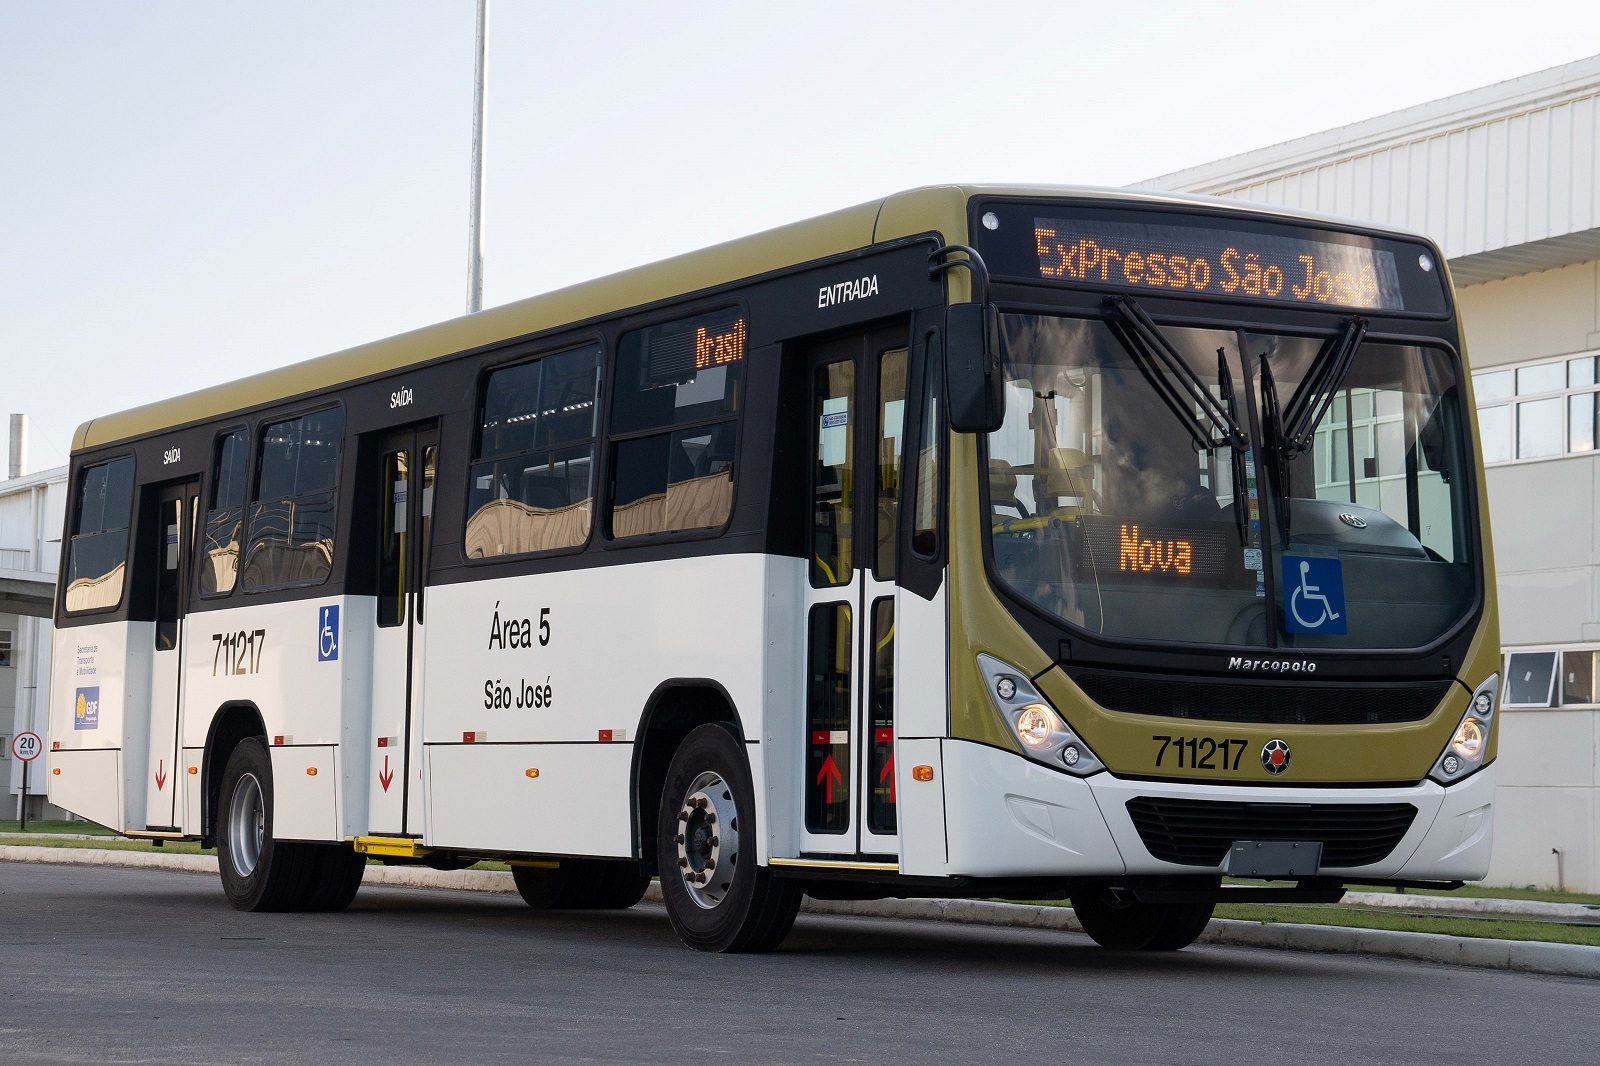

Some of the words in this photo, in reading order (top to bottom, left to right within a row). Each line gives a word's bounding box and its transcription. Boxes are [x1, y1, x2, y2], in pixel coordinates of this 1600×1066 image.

[818, 274, 879, 308] ENTRADA
[1219, 246, 1283, 296] São
[1292, 254, 1376, 305] José
[390, 385, 413, 409] SAÍDA
[163, 445, 181, 465] SAÍDA
[1120, 524, 1191, 574] Nova
[488, 600, 532, 650] Área
[538, 607, 551, 647] 5
[212, 628, 266, 677] 711217
[1228, 657, 1317, 673] Marcopolo
[86, 701, 98, 715] GDF
[484, 679, 512, 709] São
[516, 675, 552, 709] José
[20, 737, 35, 749] 20
[1152, 735, 1249, 770] 711217
